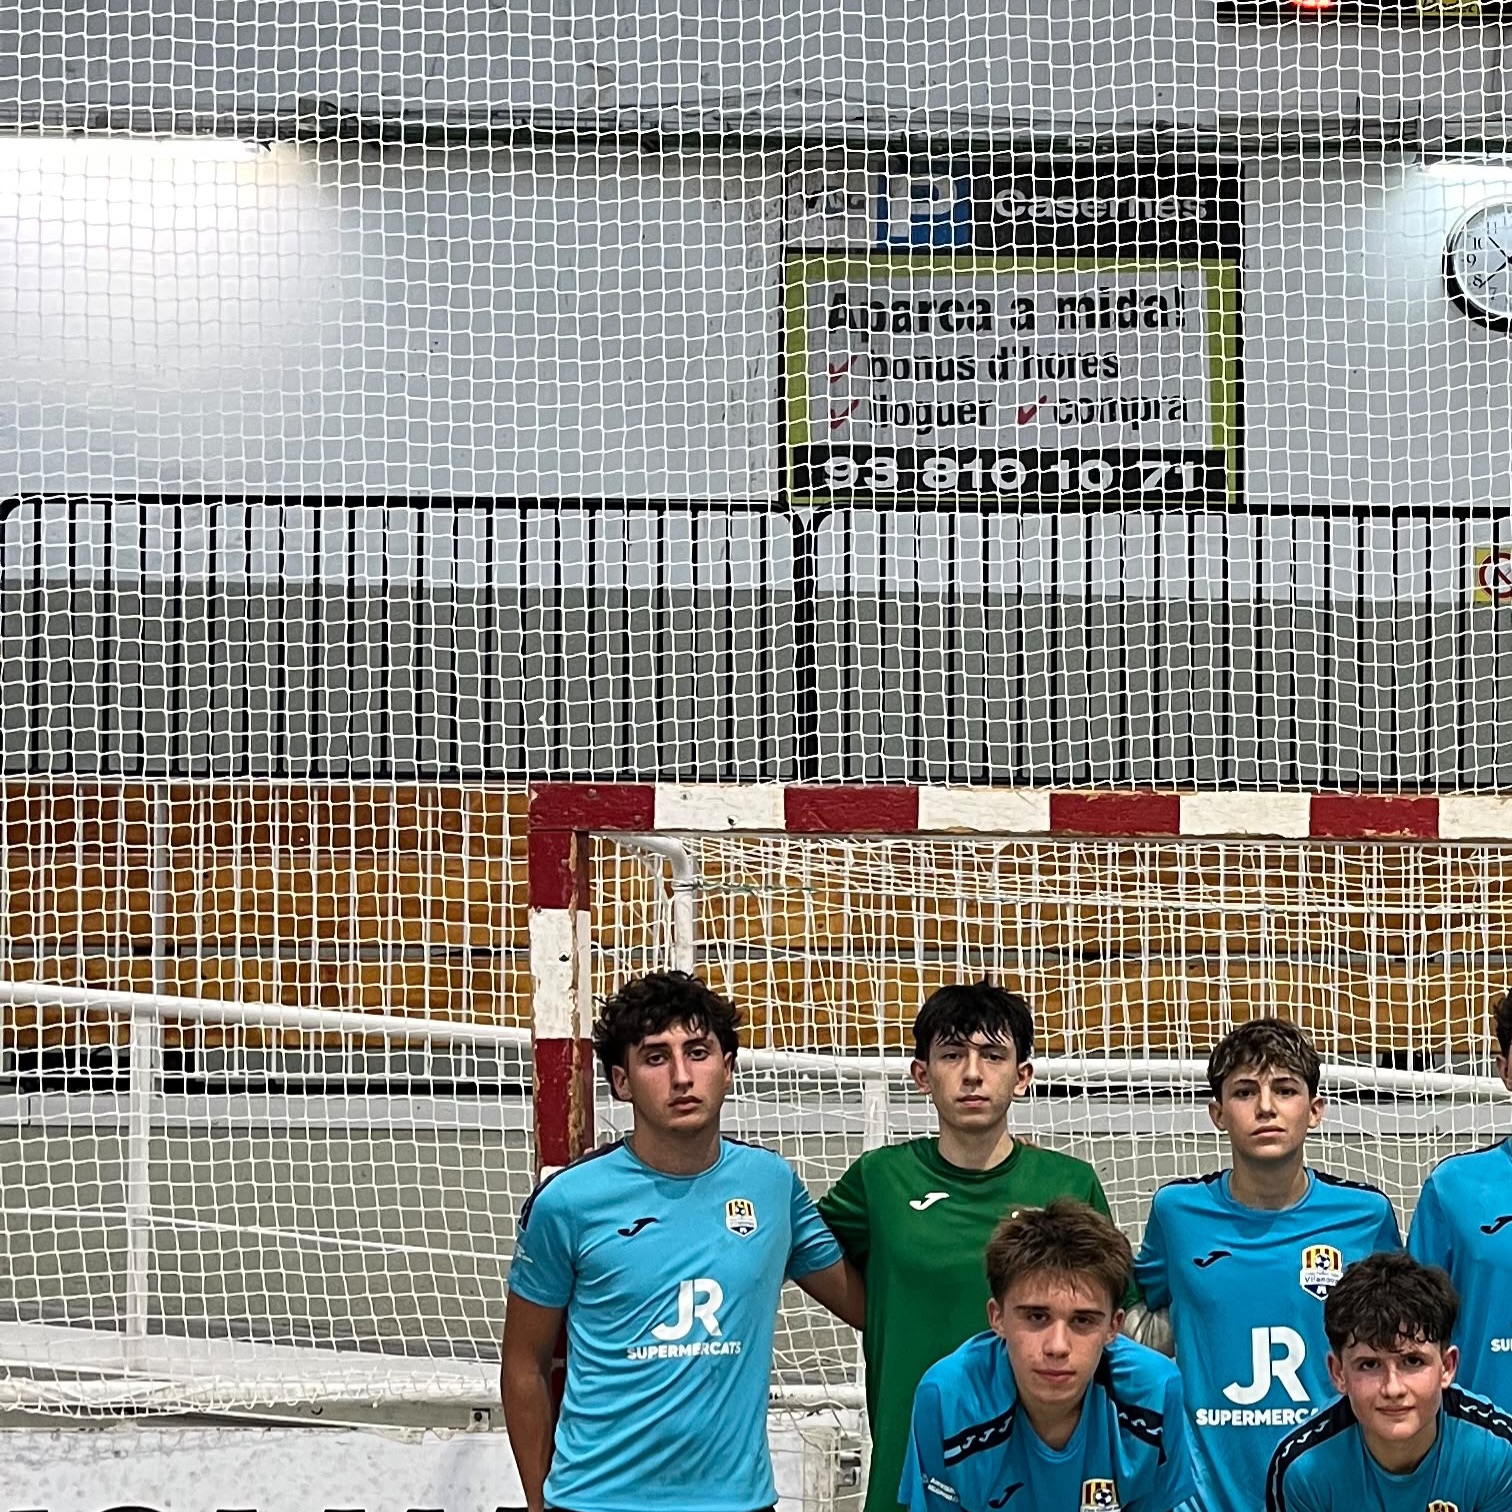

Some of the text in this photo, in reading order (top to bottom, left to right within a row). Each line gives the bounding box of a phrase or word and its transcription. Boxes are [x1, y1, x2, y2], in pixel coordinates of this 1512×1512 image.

[995, 188, 1207, 219] Casernes
[828, 286, 1186, 342] Aparca a mida!
[871, 351, 976, 383] bonus
[1052, 394, 1188, 431] compra
[824, 457, 1197, 490] 93 810 10 71
[650, 1278, 724, 1341] JR
[626, 1341, 742, 1361] SUPERMERCATS
[1222, 1326, 1311, 1406] JR
[1195, 1407, 1319, 1427] SUPERMERC
